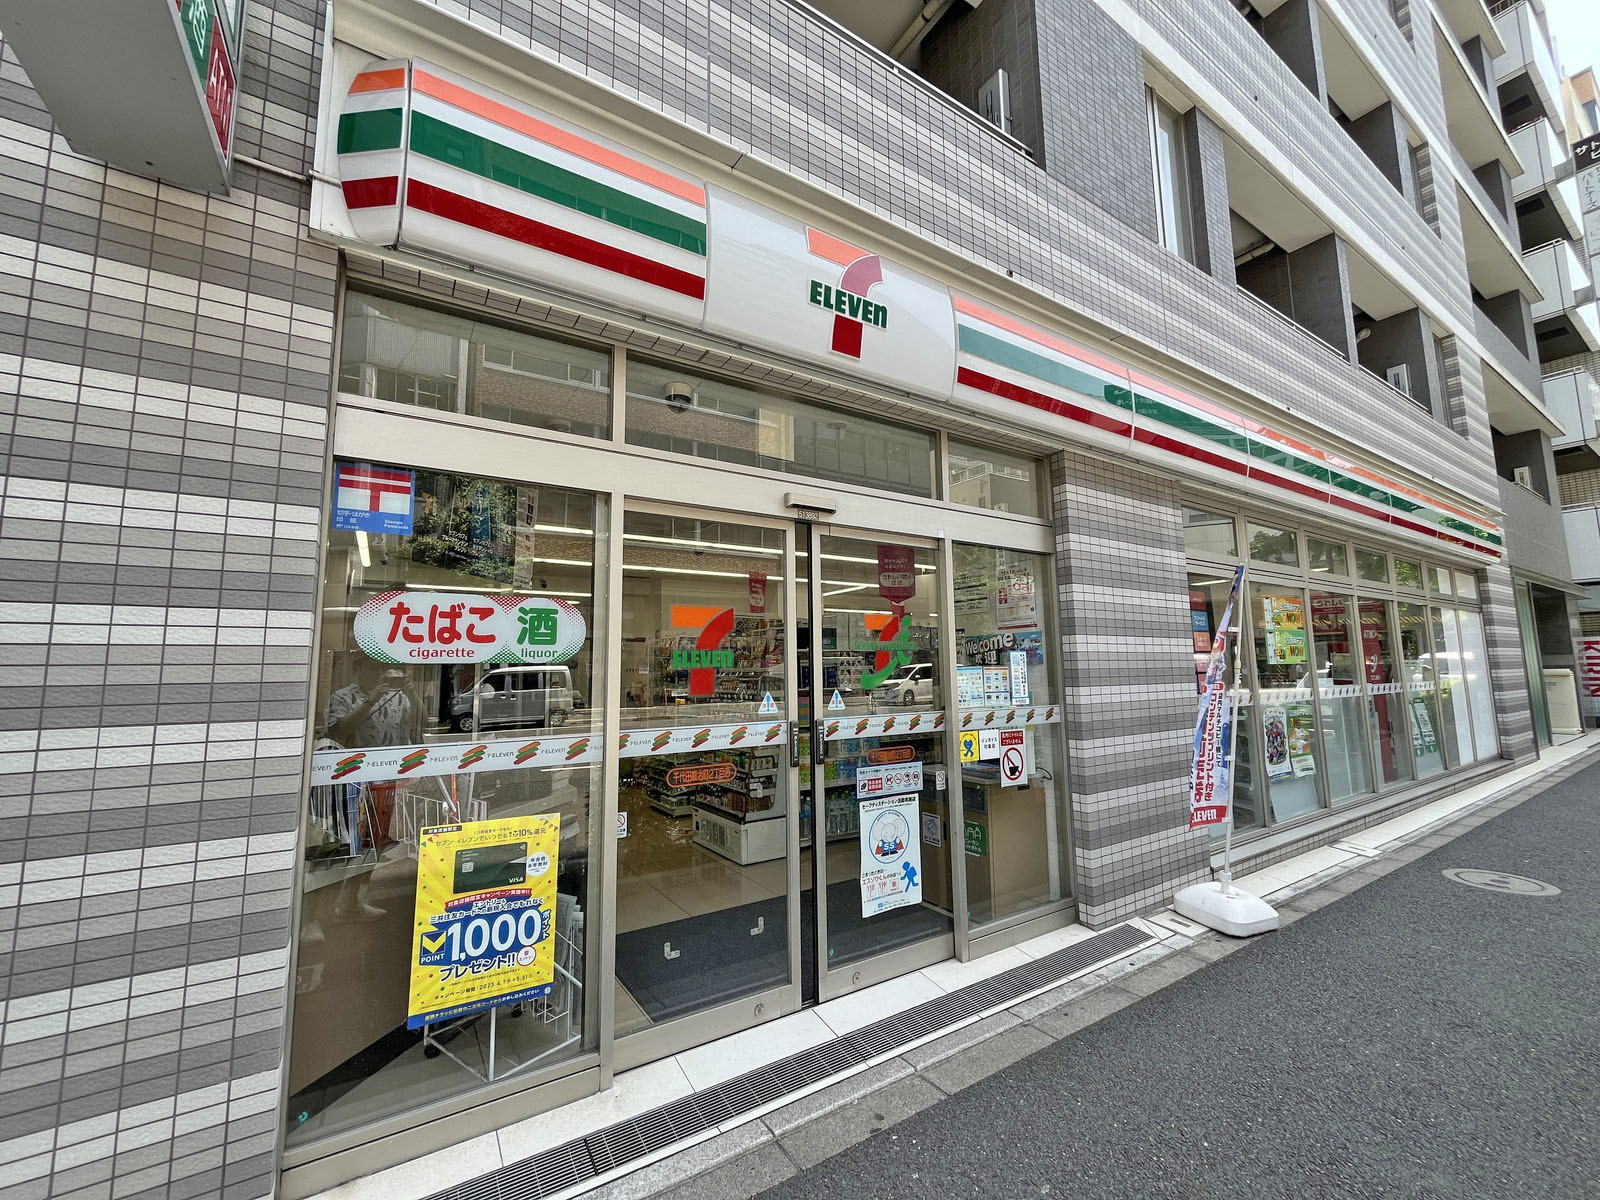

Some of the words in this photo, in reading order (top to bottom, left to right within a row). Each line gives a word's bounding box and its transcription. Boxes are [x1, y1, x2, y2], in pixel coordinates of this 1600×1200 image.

[210, 48, 232, 137] ATM
[387, 601, 496, 644] たばこ
[517, 606, 558, 645] 酒
[409, 647, 475, 660] cigarette
[521, 648, 558, 660] liquor
[965, 632, 1014, 655] Welcome
[1577, 641, 1600, 697] KIRIN
[884, 842, 895, 850] SS
[446, 909, 542, 962] 1,000
[420, 953, 445, 964] POINT
[440, 953, 516, 982] プレゼント!!
